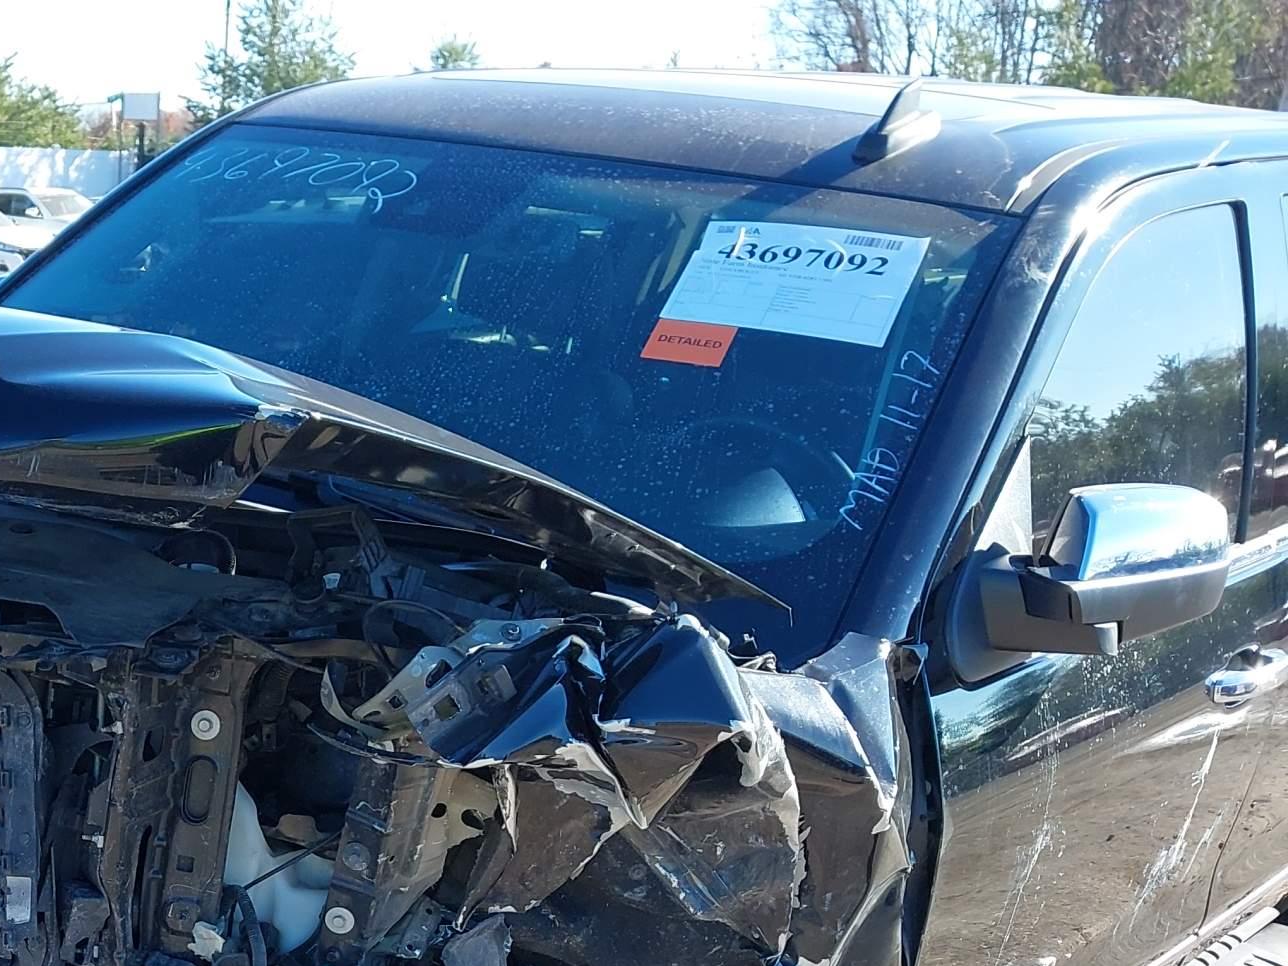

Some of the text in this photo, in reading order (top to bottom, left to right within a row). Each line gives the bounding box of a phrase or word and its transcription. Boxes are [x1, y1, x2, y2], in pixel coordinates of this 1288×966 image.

[717, 242, 889, 276] 43697092
[657, 334, 723, 350] DETAILED
[880, 350, 940, 431] 11-17
